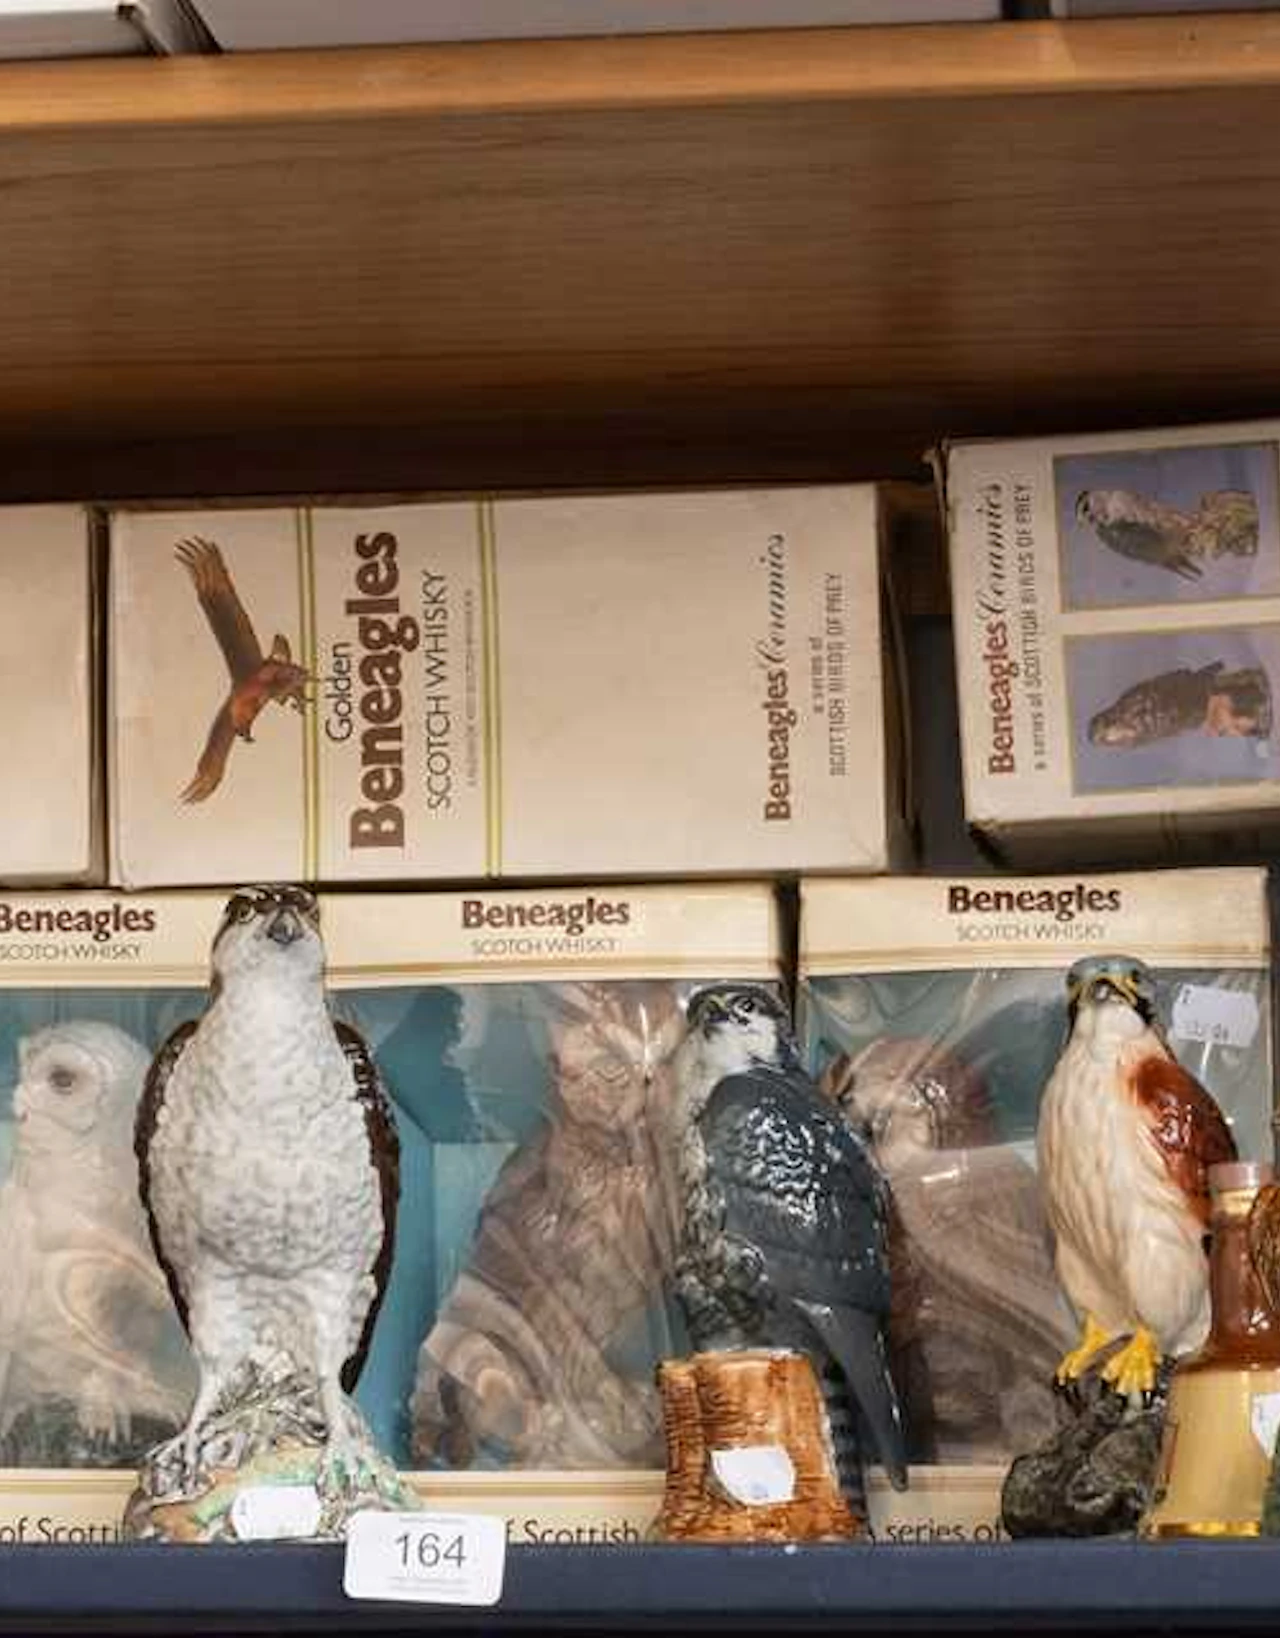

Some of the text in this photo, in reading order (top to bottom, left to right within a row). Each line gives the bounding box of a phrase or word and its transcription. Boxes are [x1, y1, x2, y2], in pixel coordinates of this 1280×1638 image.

[1013, 484, 1032, 524] PREY
[1016, 529, 1035, 548] OF
[1018, 553, 1038, 604] BIRDS
[975, 483, 1018, 774] Beneagles Ceramics
[1022, 611, 1043, 688] SCOTTISH
[325, 641, 352, 742] Golden
[345, 532, 420, 849] Beneagles
[421, 570, 451, 810] SCOTCH WHISKY
[755, 534, 796, 821] Beneagles Ceramics
[825, 573, 847, 777] SCOTTISH BIRDS OF PREY
[463, 897, 630, 936] Beneagles
[948, 884, 1121, 921] Beneagles
[0, 944, 142, 960] SCOTCH WHISKY
[473, 938, 618, 955] SCOTCH WHISKY
[957, 924, 1106, 941] SCOTCH WHISKY
[38, 1517, 120, 1543] Scotti
[524, 1519, 639, 1544] Scottish
[887, 1518, 965, 1544] series
[395, 1532, 467, 1568] 164
